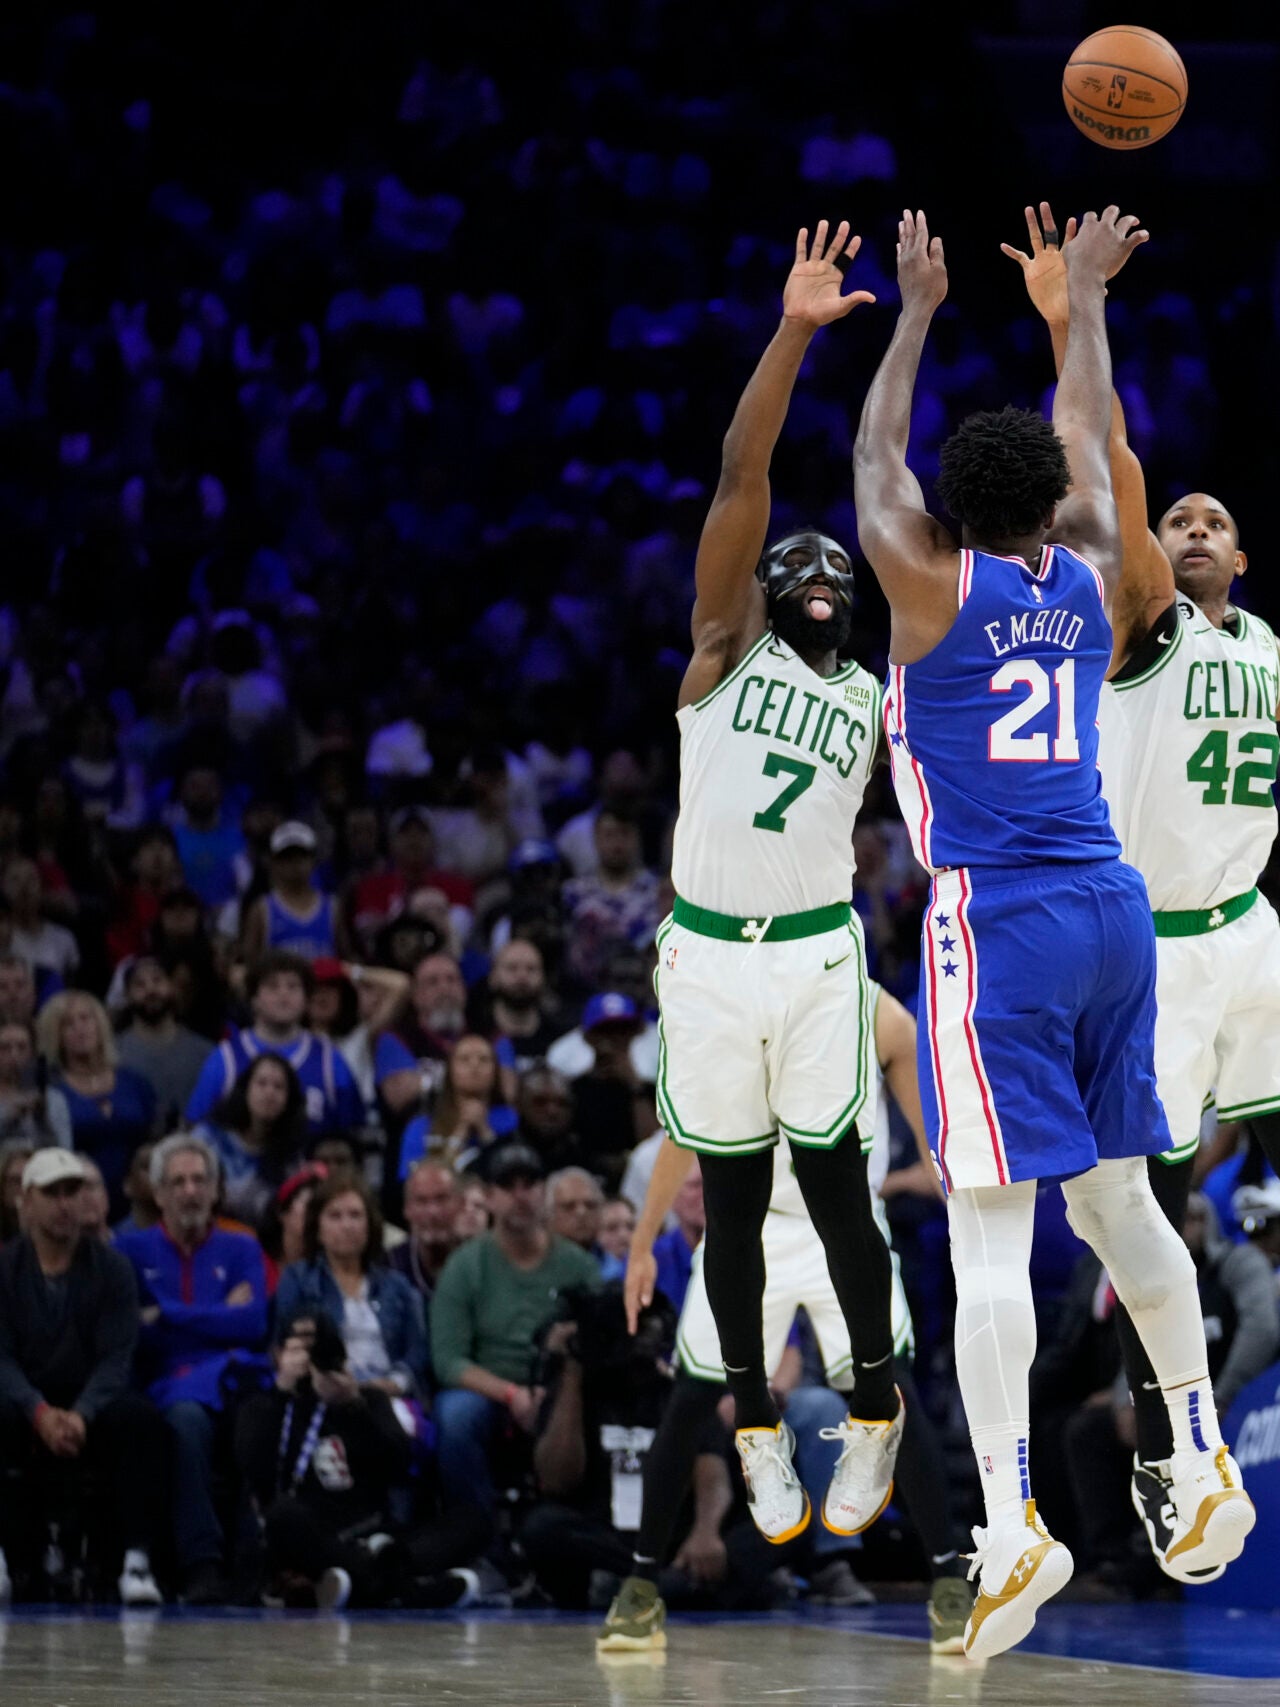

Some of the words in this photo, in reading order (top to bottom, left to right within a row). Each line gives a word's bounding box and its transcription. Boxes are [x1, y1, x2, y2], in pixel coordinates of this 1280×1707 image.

[983, 609, 1085, 657] EMBIID
[843, 695, 869, 709] PRINT
[844, 685, 870, 700] VISTA
[988, 658, 1080, 763] 21
[732, 675, 866, 779] CELTICS
[752, 751, 818, 833] 7
